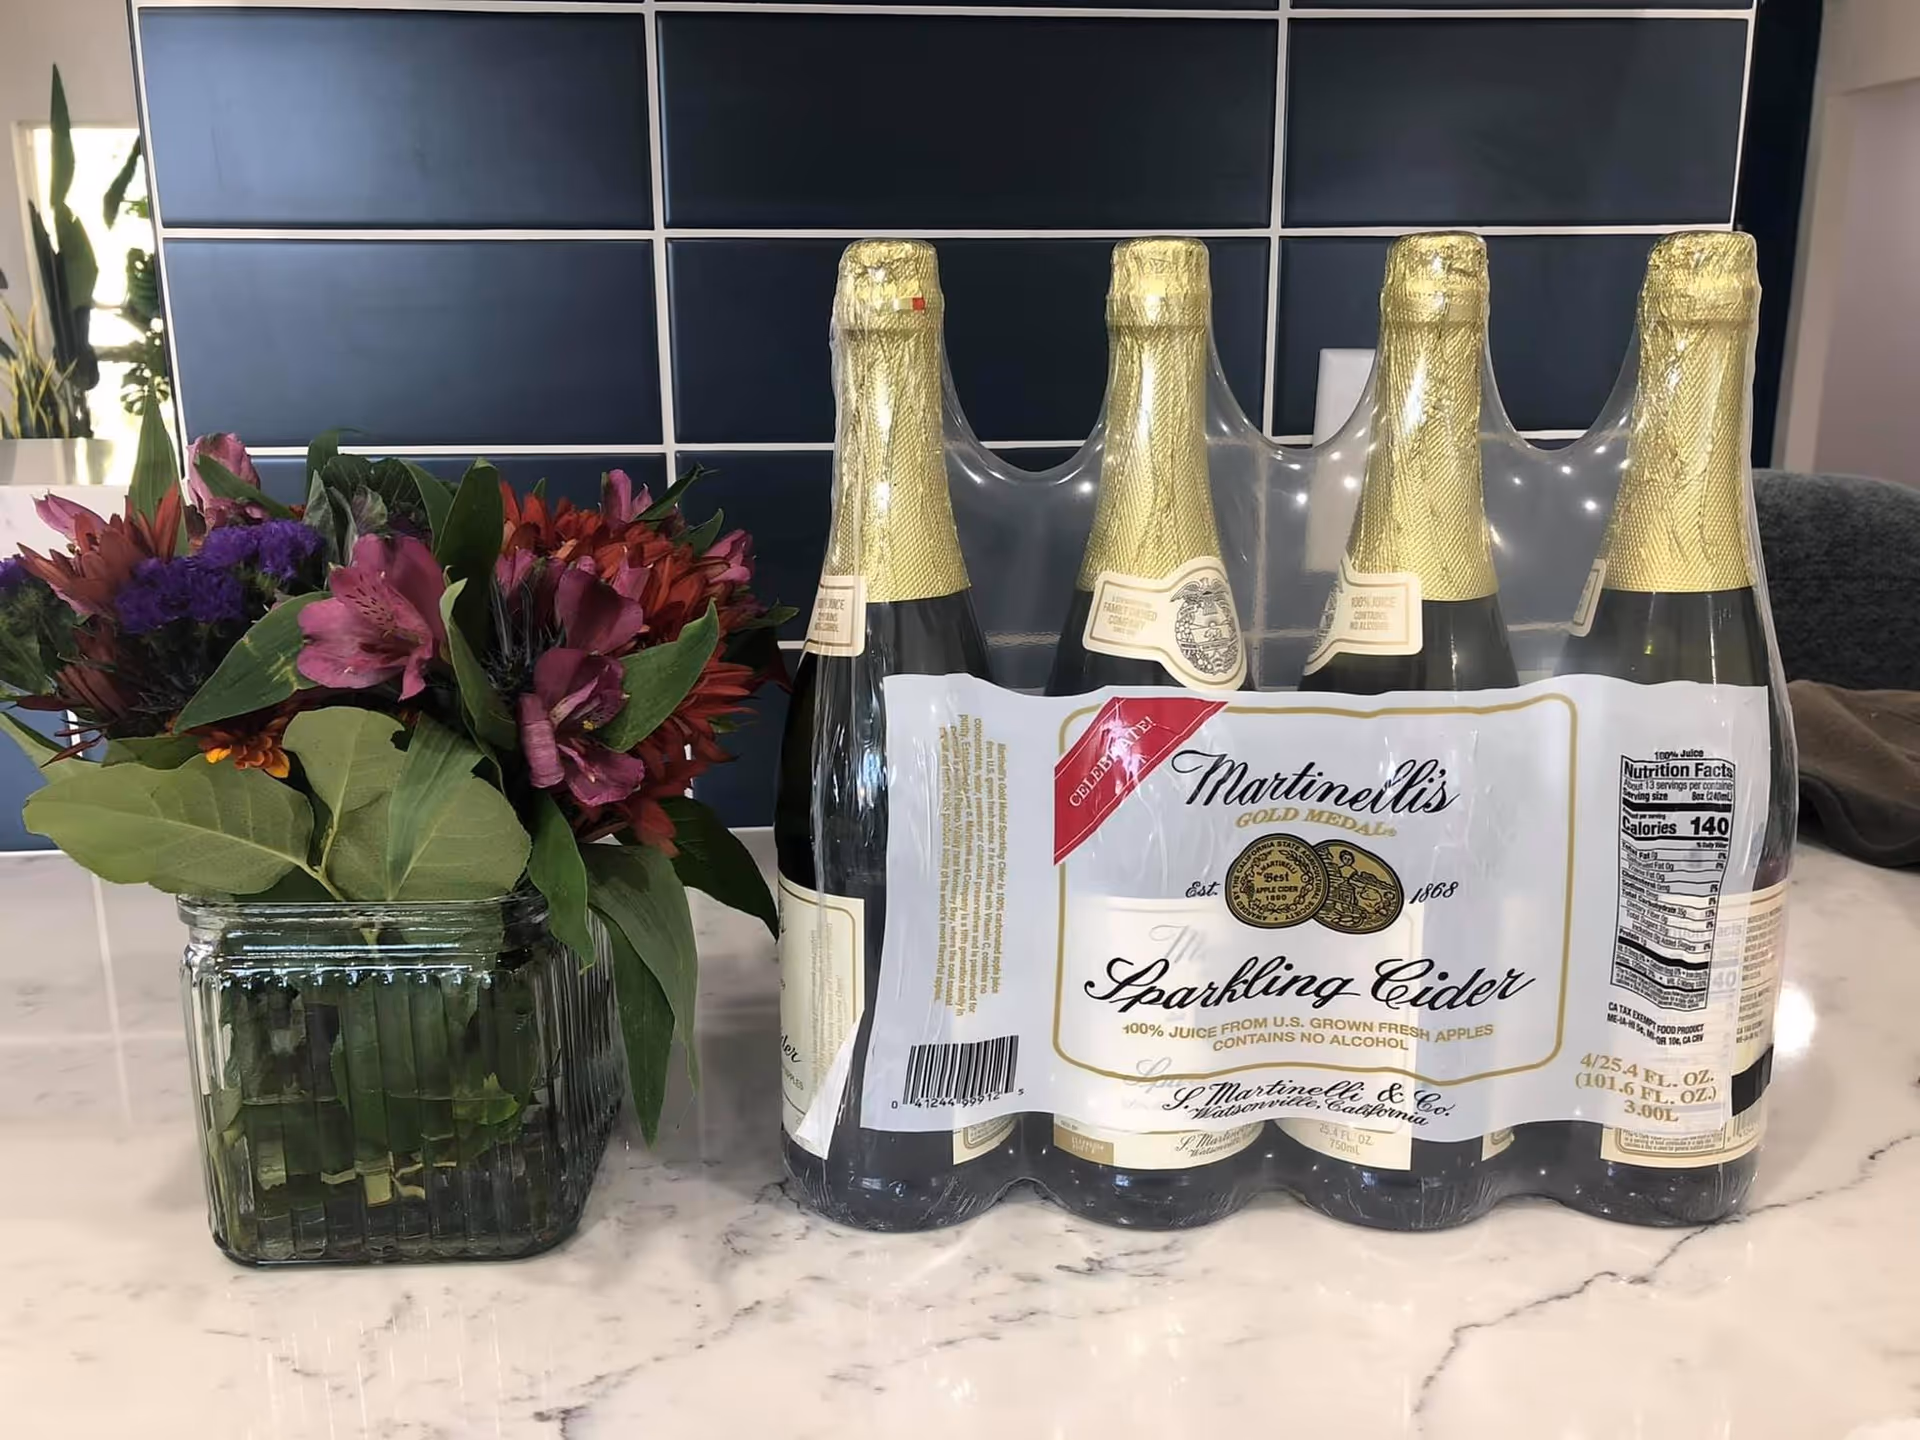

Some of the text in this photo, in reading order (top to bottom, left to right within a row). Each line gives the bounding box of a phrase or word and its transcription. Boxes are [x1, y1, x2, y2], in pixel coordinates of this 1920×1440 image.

[1680, 749, 1704, 758] Juice
[1624, 760, 1733, 779] Nutrition Facts
[998, 783, 1007, 800] Gold
[1171, 749, 1462, 814] Martinelli's
[1645, 781, 1655, 789] 13
[1656, 782, 1688, 792] servings
[1689, 782, 1700, 791] per
[1702, 781, 1734, 790] containe
[1652, 791, 1668, 801] size
[1234, 806, 1299, 829] GOLD
[1622, 815, 1730, 836] Calories 140
[1276, 840, 1301, 852] STATE
[1639, 852, 1650, 860] Fat
[1654, 862, 1665, 870] Fat
[1185, 880, 1459, 904] Est. 1868
[980, 984, 988, 994] no
[1084, 956, 1535, 1013] Sparkling Cider
[1608, 1001, 1705, 1035] CA TAX EXEMPT FOOD PRODUCT
[1122, 1016, 1494, 1043] 100% JUICE FROM U.S. GROWN FRESH APPLES
[1682, 1036, 1691, 1044] CA
[1692, 1033, 1704, 1043] CRV
[1213, 1031, 1409, 1052] CONTAINS NO ALCOHOL
[1580, 1052, 1715, 1088] 4/25.4 FL. OZ.
[1575, 1071, 1717, 1105] (101.6 FL. OZ.)
[914, 1098, 955, 1108] 41244
[961, 1092, 1001, 1108] 99912
[1162, 1080, 1458, 1117] S. Martinelli & Co.
[1324, 1098, 1430, 1126] California
[1624, 1099, 1679, 1123] 3.00L
[1319, 1122, 1338, 1138] 25.4
[1329, 1138, 1360, 1156] 750mL
